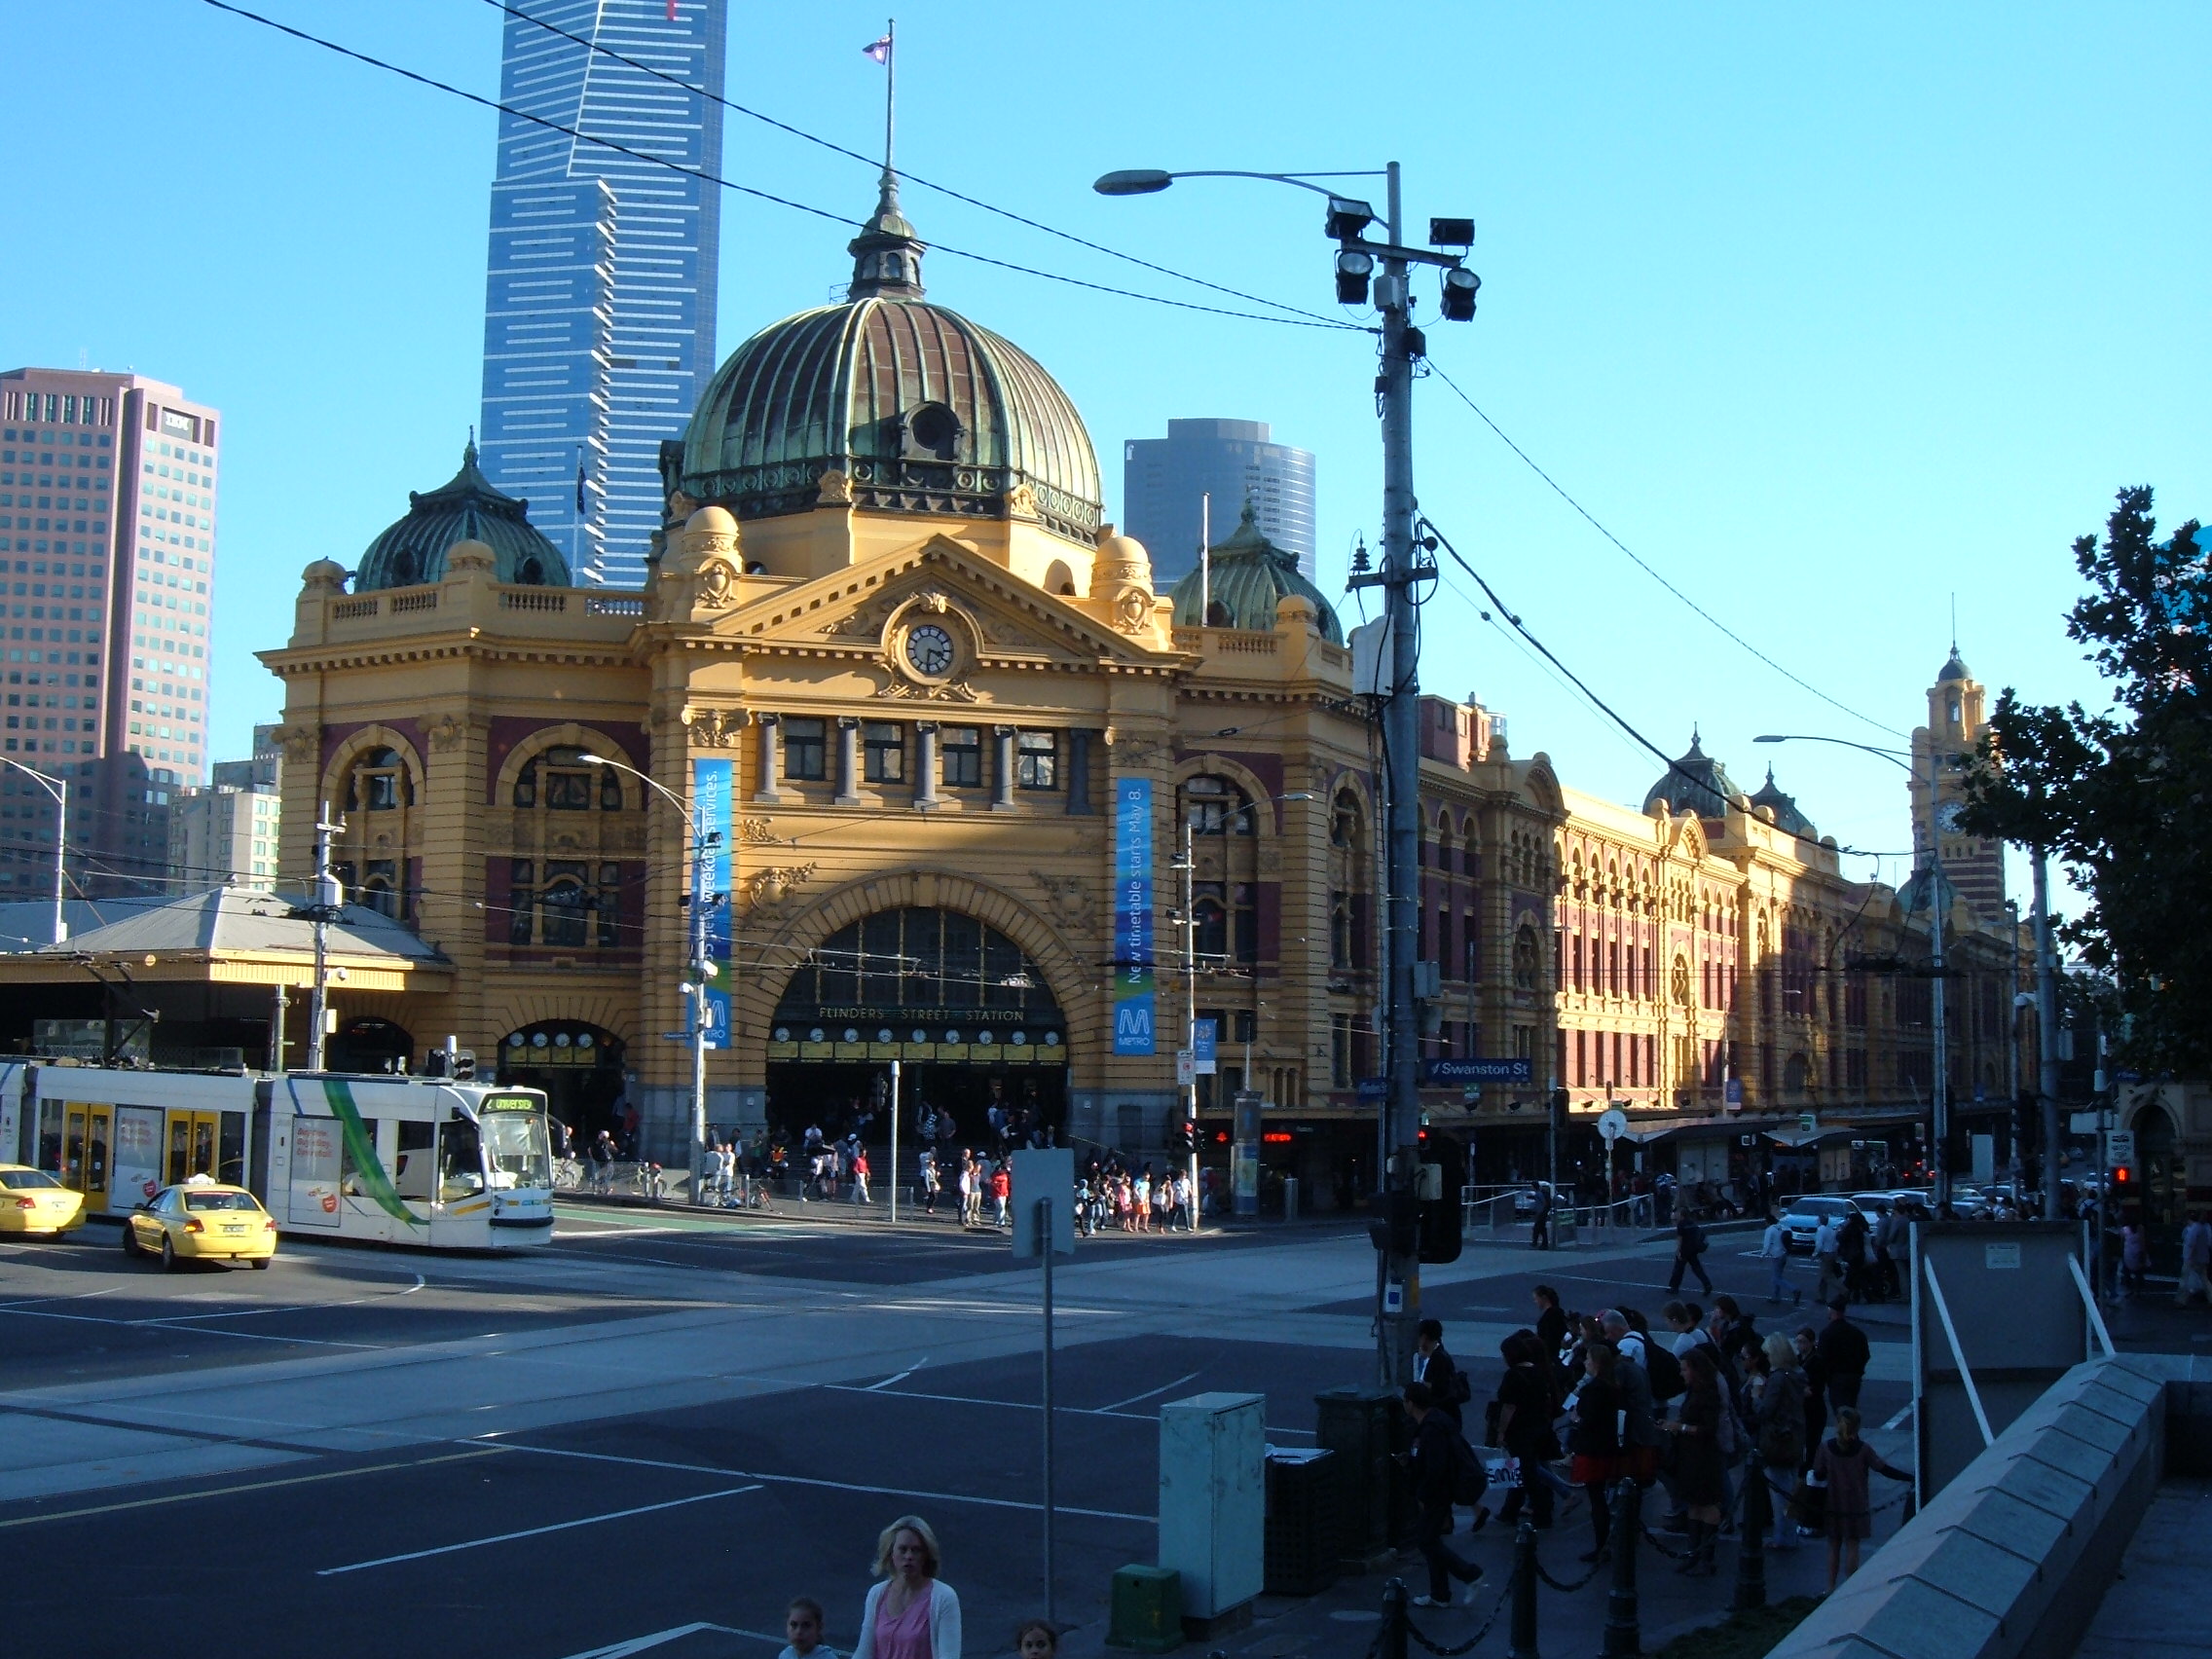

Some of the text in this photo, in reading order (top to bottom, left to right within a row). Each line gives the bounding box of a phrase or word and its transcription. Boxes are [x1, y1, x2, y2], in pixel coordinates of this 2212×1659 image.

[704, 770, 718, 833] services.
[1128, 788, 1144, 983] New timetable starts May 8.
[819, 1007, 1023, 1021] FLINDERS STREET STATION
[1119, 1037, 1150, 1046] METRO
[1442, 1062, 1529, 1075] Swanston St
